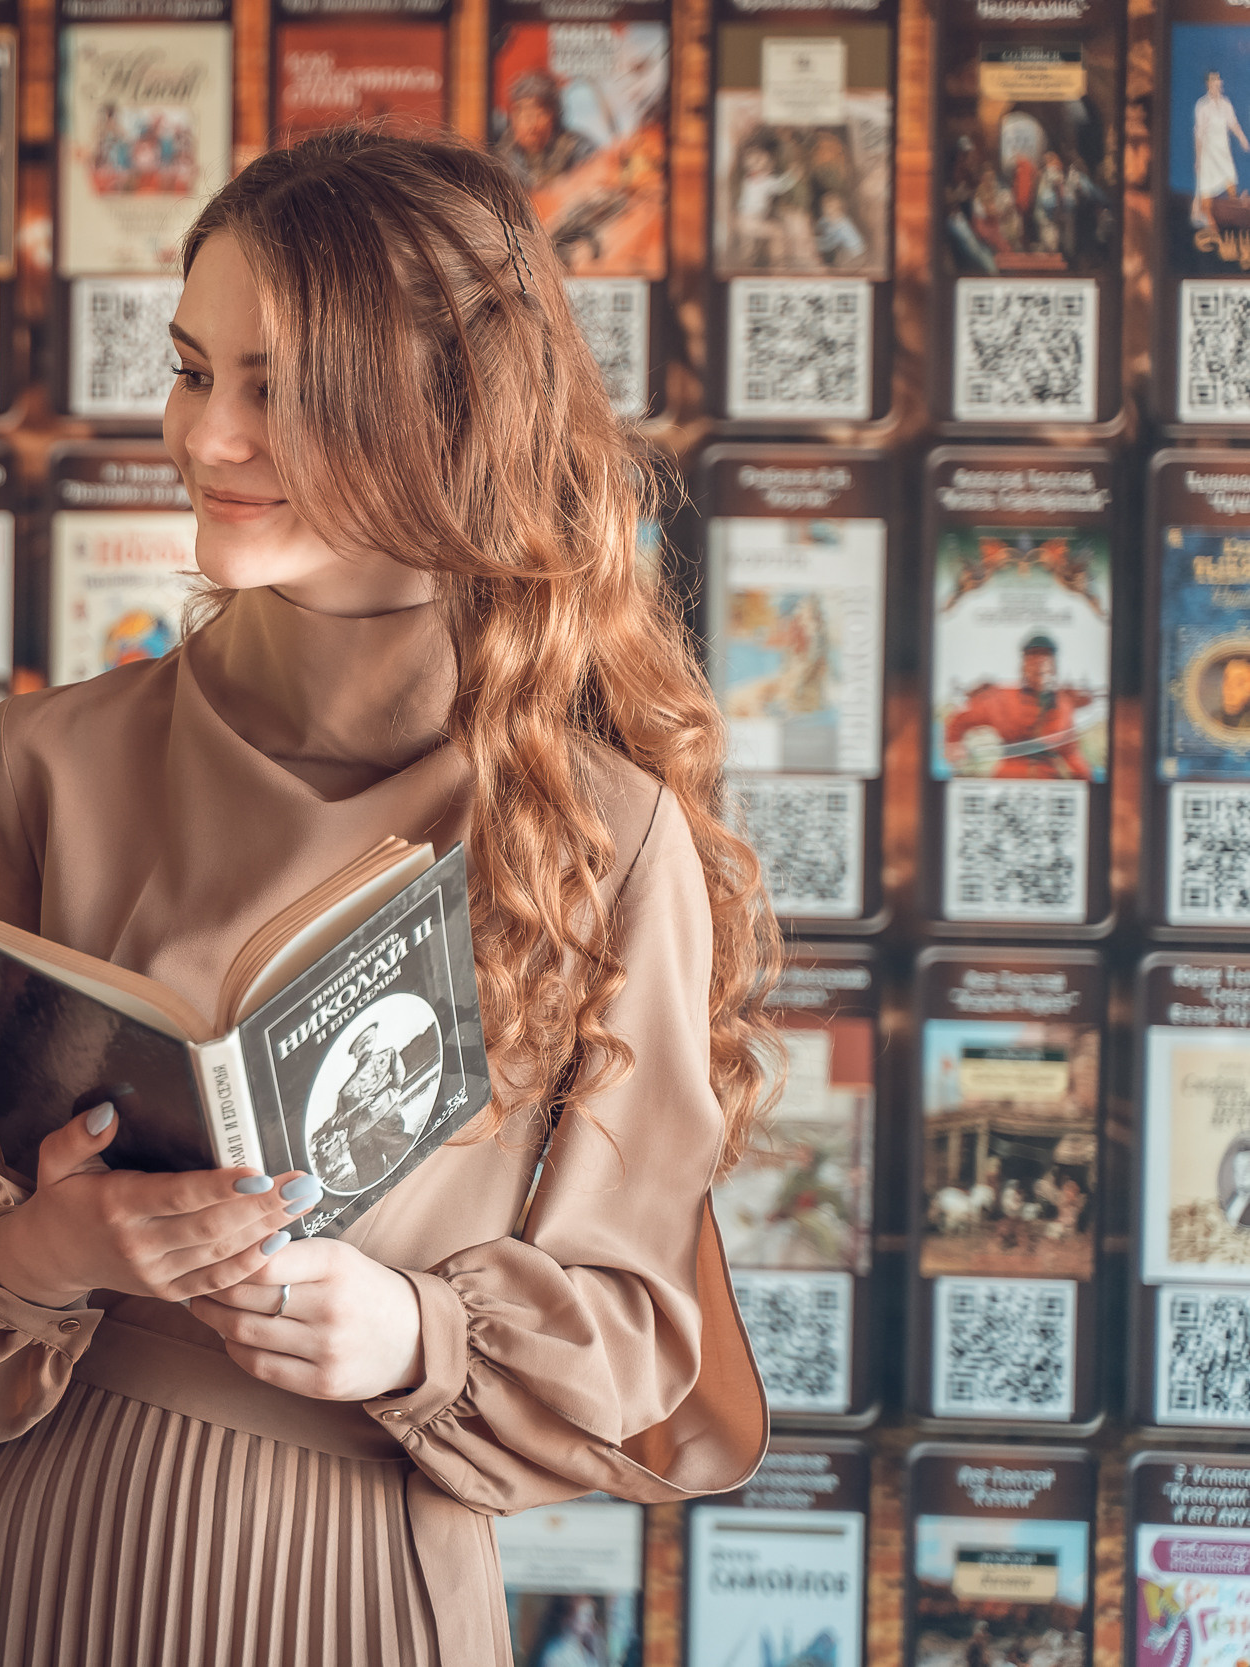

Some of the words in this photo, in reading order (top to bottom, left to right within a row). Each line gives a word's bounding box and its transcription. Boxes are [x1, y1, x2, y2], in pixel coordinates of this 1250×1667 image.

[277, 936, 410, 1061] НИКОЛАЙ
[413, 916, 434, 947] II
[315, 1028, 328, 1045] И
[330, 1005, 356, 1033] ЕГО
[356, 965, 403, 1009] СЕМЬЯ
[212, 1063, 232, 1099] СЕМЬЯ
[220, 1099, 237, 1121] ЕГО
[224, 1120, 238, 1131] И
